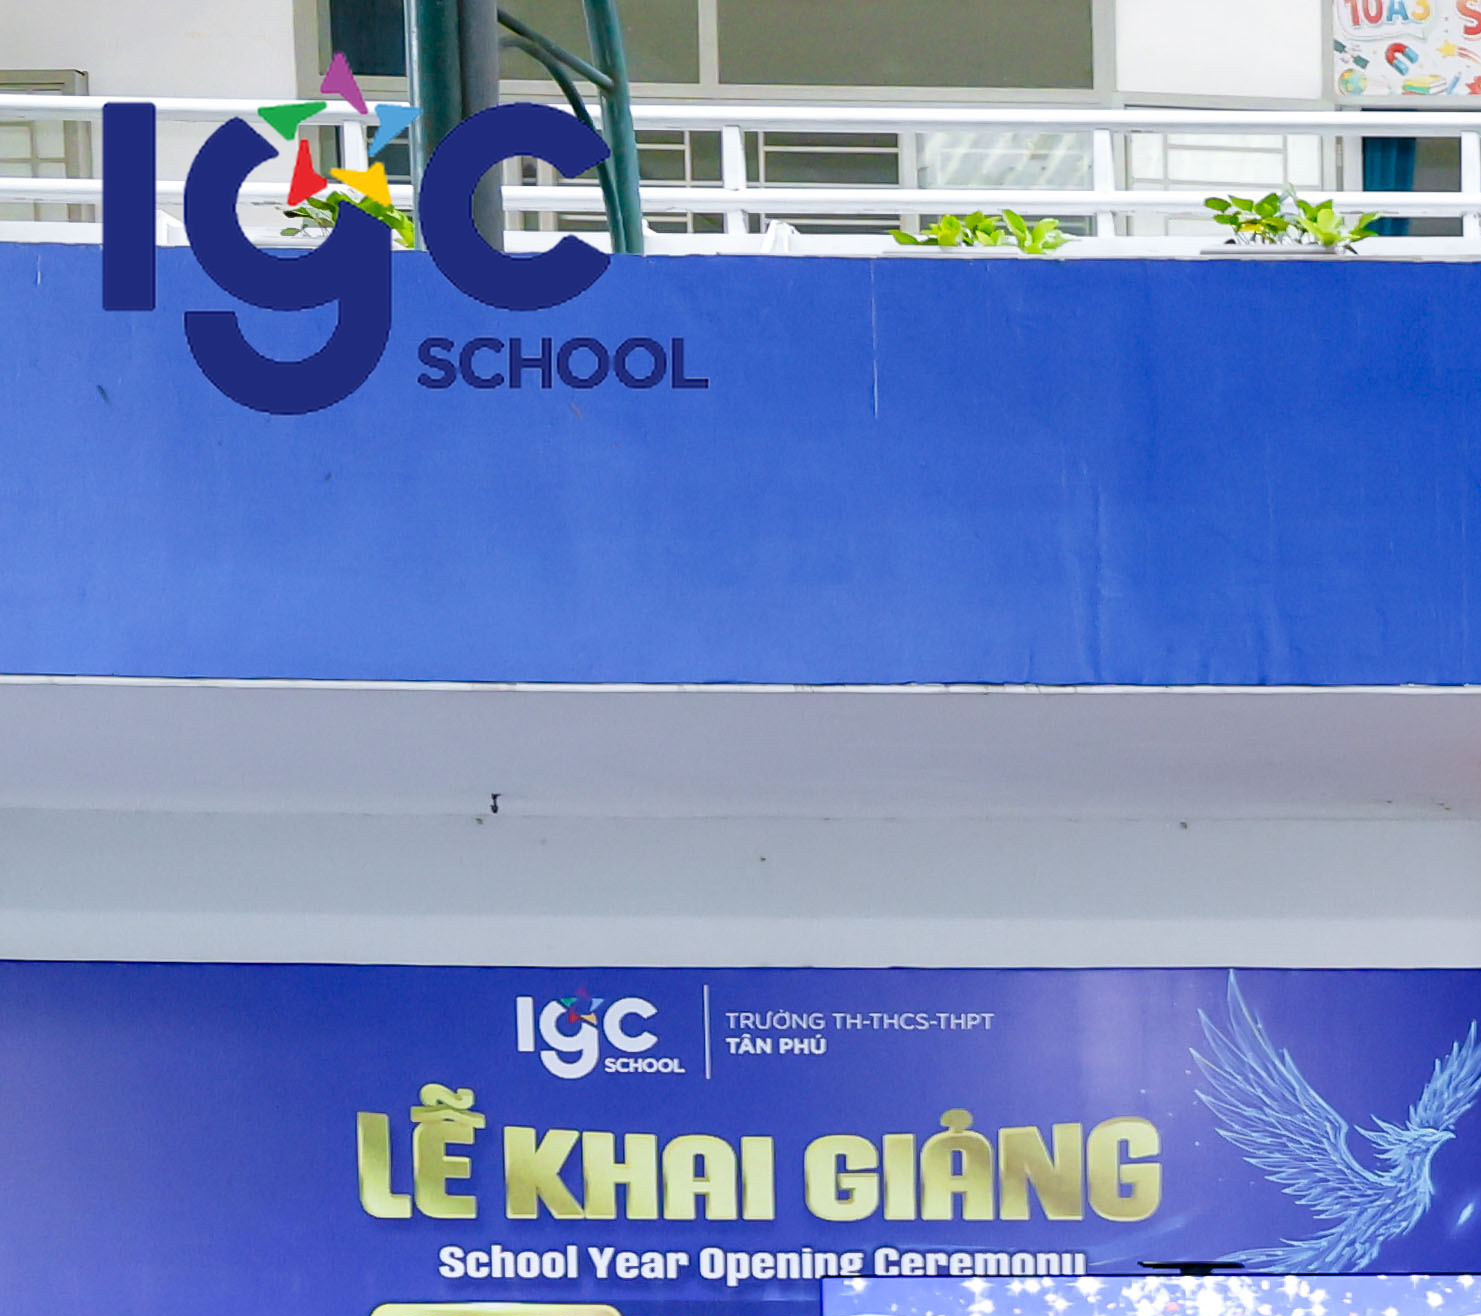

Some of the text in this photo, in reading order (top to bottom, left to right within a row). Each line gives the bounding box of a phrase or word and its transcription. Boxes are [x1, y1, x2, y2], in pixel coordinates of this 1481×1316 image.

[726, 1010, 995, 1032] TRƯỜNG TH-THCS-THPT
[726, 1034, 828, 1056] TÂN PHÚ
[604, 1057, 687, 1074] SCHOOL
[357, 1084, 1164, 1222] LỄ KHAI GIẢNG
[440, 1245, 579, 1281] School
[588, 1247, 690, 1281] Year
[700, 1247, 865, 1288] Opening
